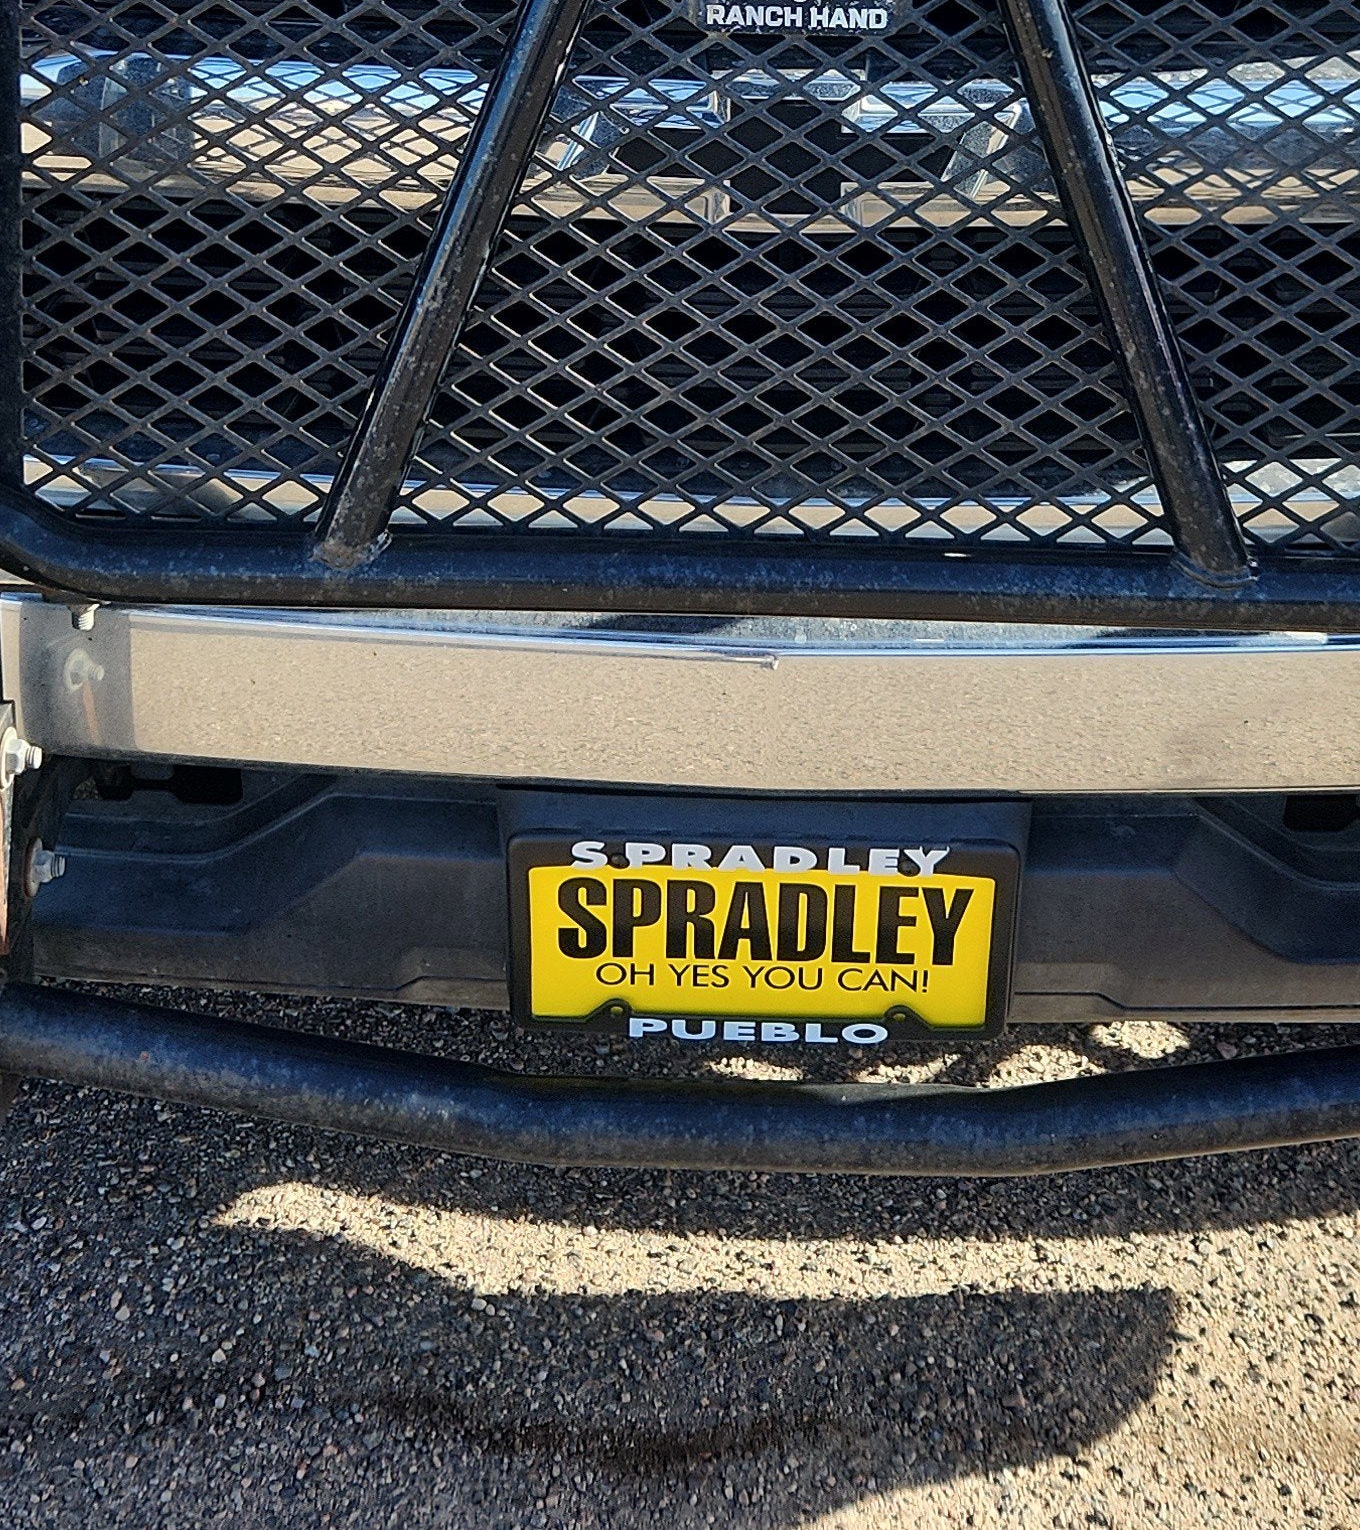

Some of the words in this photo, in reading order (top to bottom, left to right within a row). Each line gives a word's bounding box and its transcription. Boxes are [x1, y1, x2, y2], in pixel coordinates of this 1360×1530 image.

[706, 4, 802, 27] RANCH
[810, 6, 889, 29] HAND
[557, 877, 974, 965] SPRADLEY
[596, 962, 655, 986] OH
[668, 964, 729, 989] YES
[742, 965, 823, 991] YOU
[837, 967, 929, 993] CAN!
[628, 1017, 889, 1044] PUEBLO
